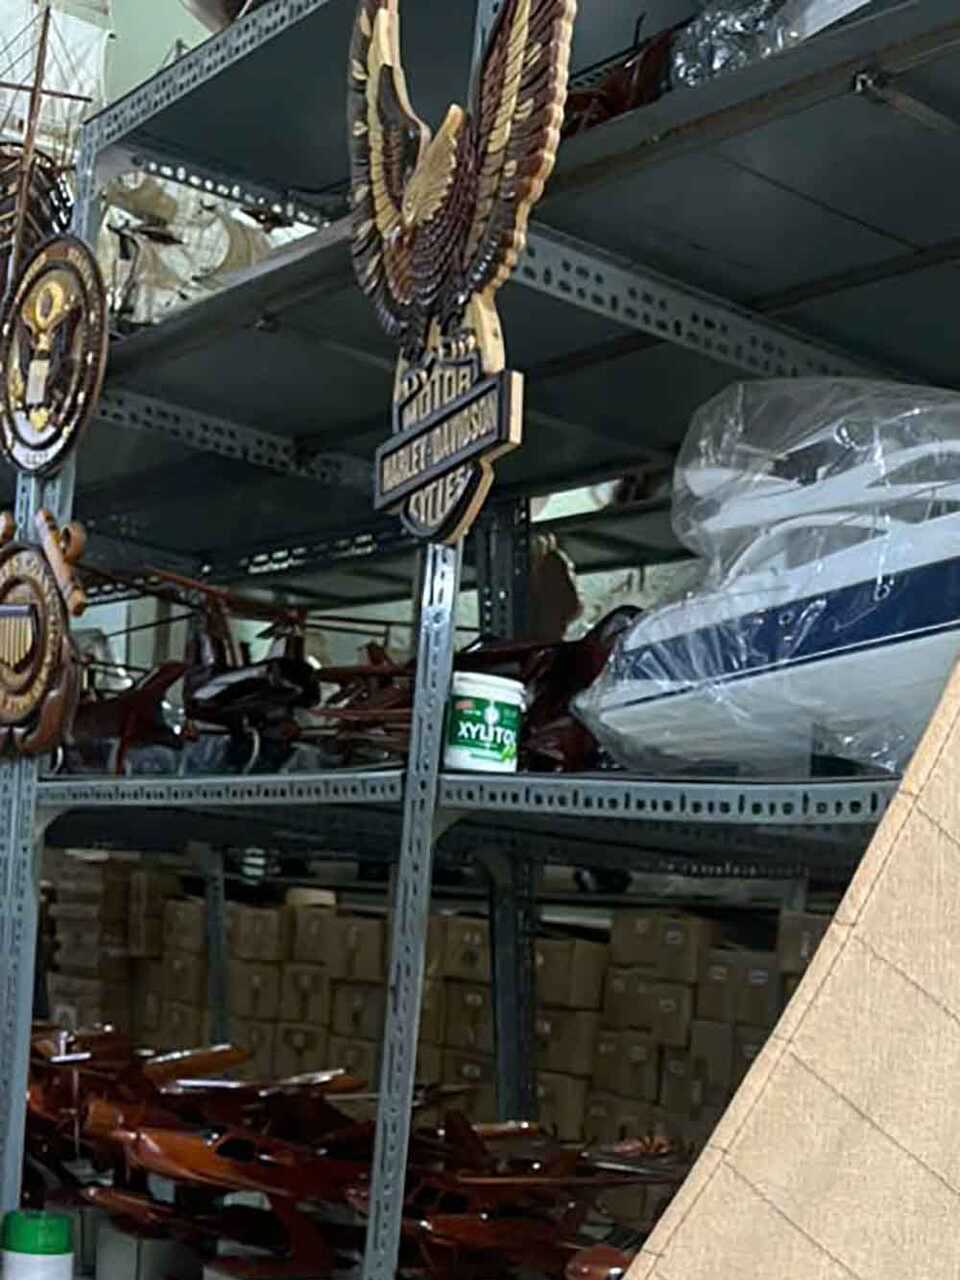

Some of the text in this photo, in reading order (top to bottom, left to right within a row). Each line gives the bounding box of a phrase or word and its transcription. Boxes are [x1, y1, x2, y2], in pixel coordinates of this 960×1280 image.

[402, 366, 472, 429] MOTOR
[383, 390, 499, 494] HARLEY-DAVIDSON
[457, 721, 517, 745] XYLITO
